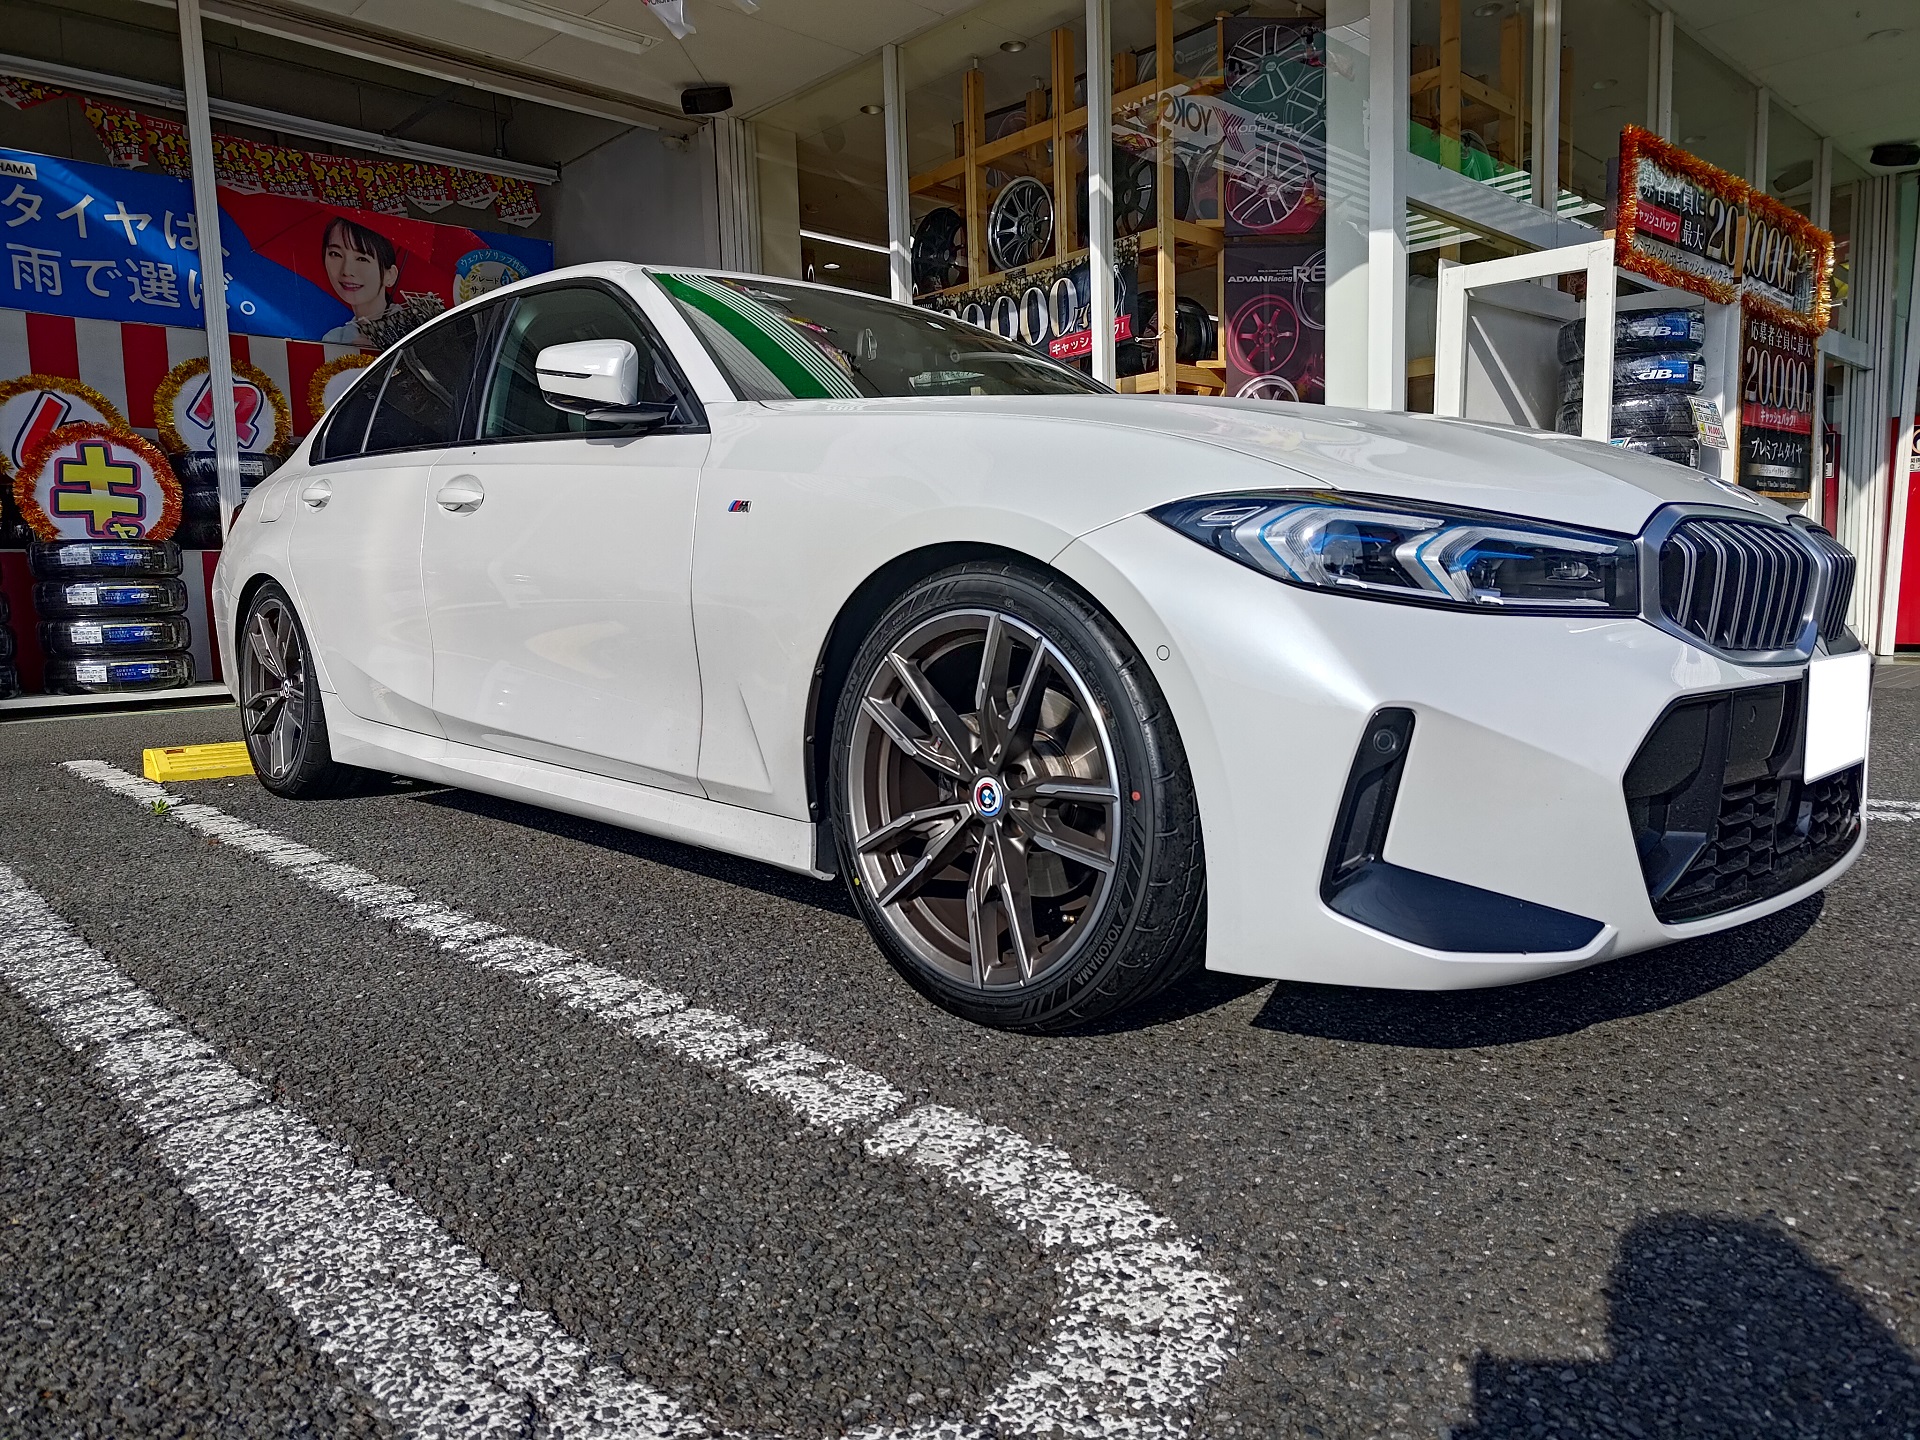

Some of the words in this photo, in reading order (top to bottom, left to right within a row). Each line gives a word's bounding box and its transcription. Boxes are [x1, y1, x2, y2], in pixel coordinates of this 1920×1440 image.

[147, 119, 181, 132] ヨコハマ
[1227, 125, 1272, 134] MODEL
[254, 148, 304, 169] タイヤ
[314, 155, 343, 164] ヨコハマ
[310, 160, 352, 182] タイヤ
[356, 163, 399, 187] タイヤ
[496, 188, 533, 206] 大商談会
[1682, 219, 1704, 250] 最大
[470, 274, 500, 285] グレード
[1228, 275, 1268, 283] ADVAN
[1268, 275, 1293, 283] Racing
[1638, 326, 1672, 337] dB
[1750, 318, 1812, 358] 応募者全員に最大
[1637, 368, 1673, 380] dB
[1744, 345, 1812, 413] 20,000円
[1751, 436, 1803, 463] プレミアムタイヤ
[858, 626, 889, 671] APEX
[1073, 921, 1124, 986] YOKOHAMA
